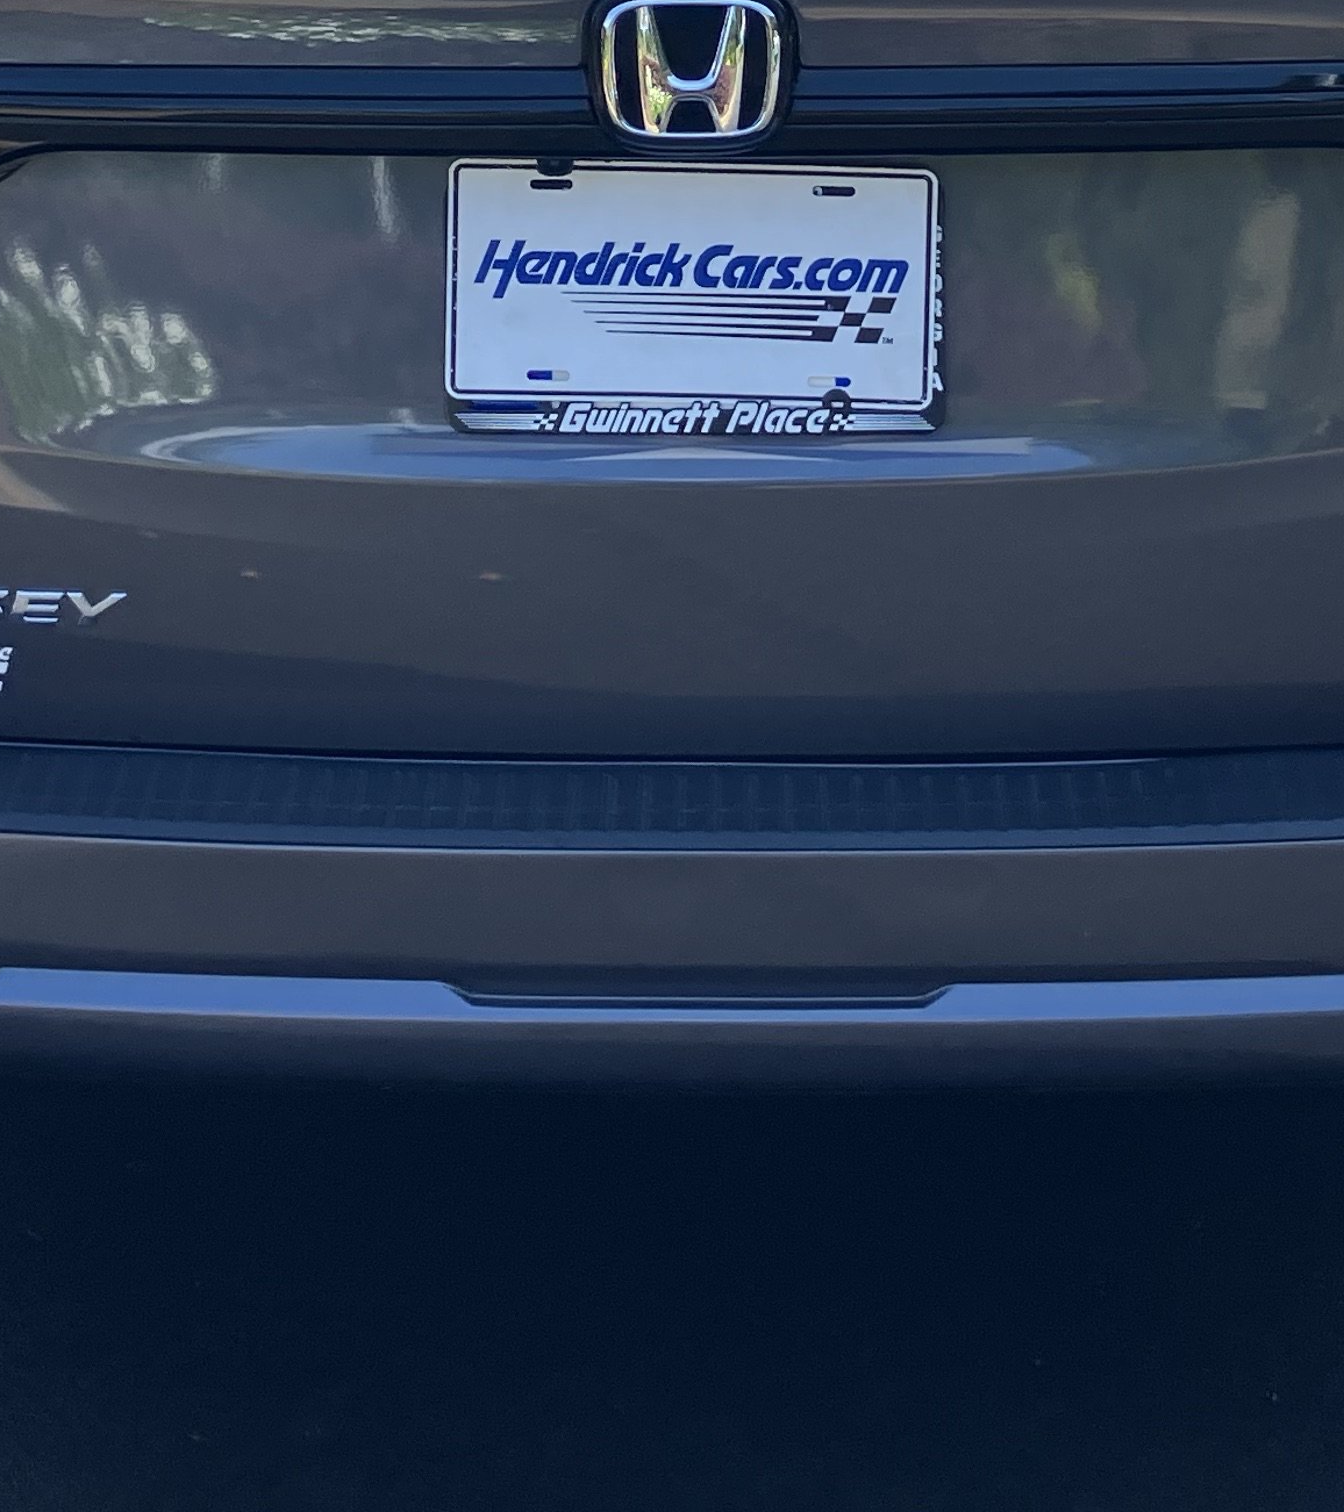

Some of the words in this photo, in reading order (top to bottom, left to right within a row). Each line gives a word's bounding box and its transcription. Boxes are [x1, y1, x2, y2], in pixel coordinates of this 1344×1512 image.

[882, 337, 894, 345] TM
[558, 401, 721, 434] Gwinnett
[725, 401, 830, 434] Place
